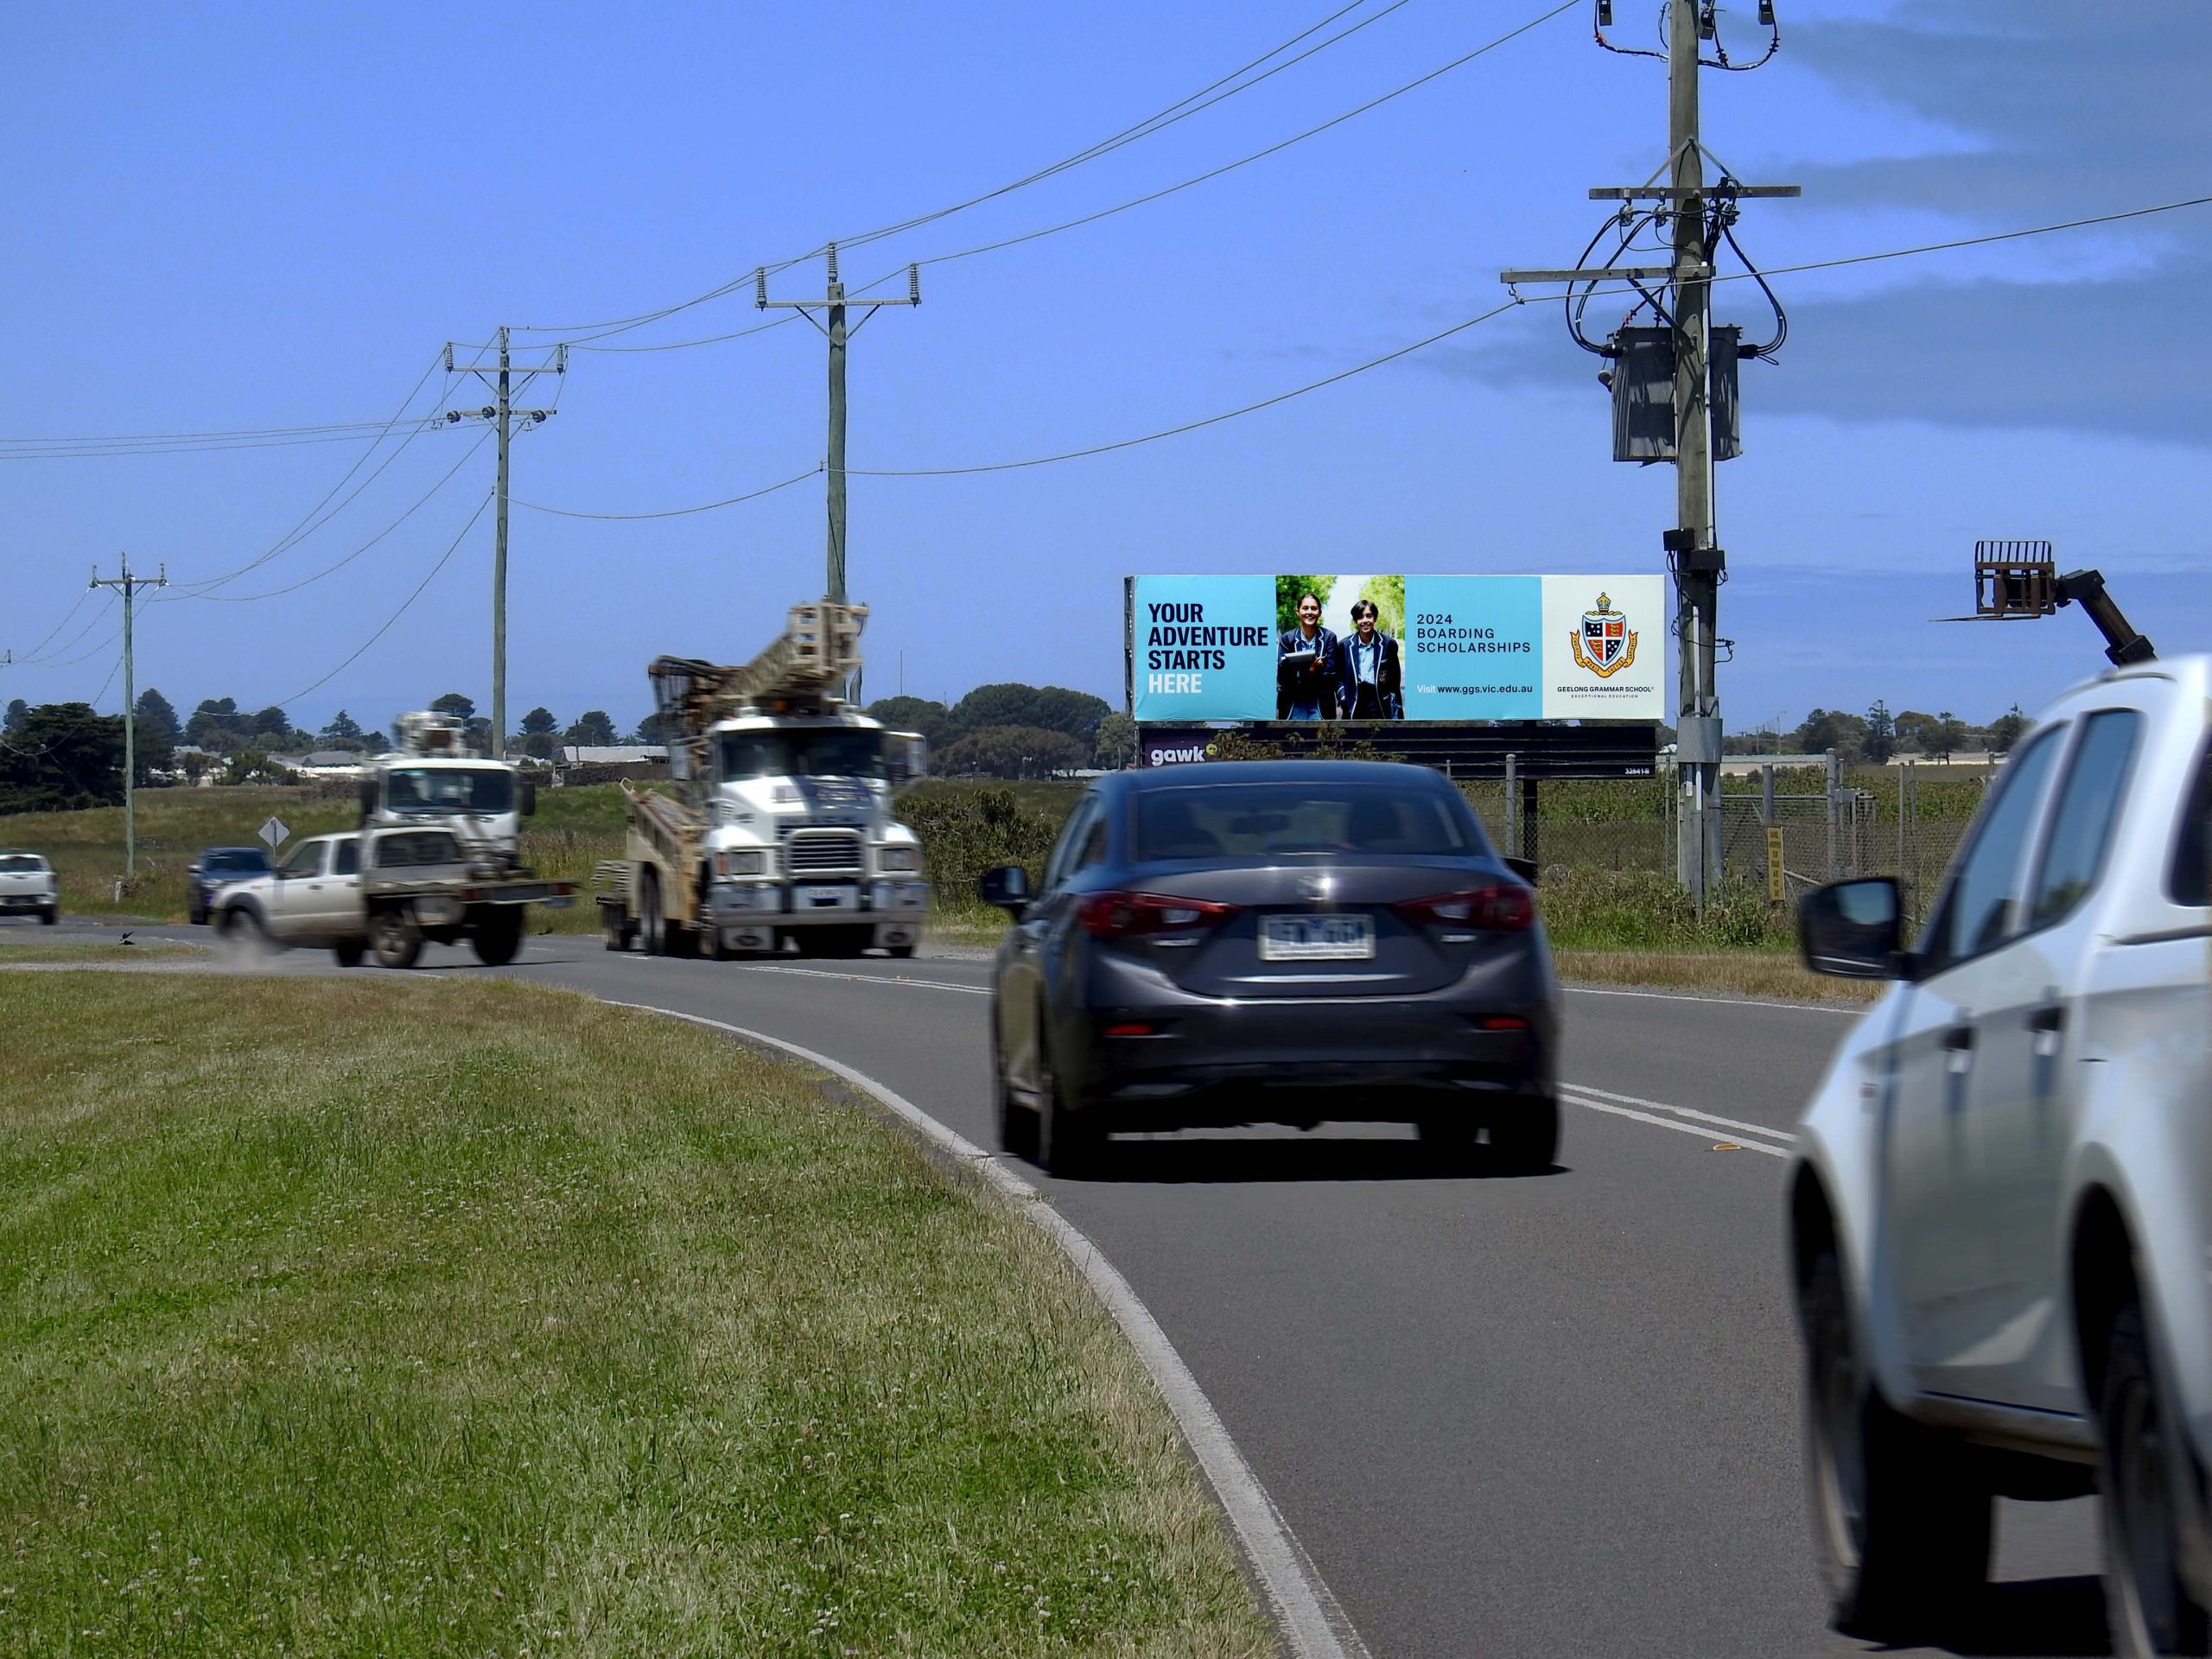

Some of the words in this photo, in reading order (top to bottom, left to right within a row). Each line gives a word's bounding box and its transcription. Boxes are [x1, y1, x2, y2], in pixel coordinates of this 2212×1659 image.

[1147, 603, 1204, 623] YOUR
[1416, 613, 1452, 625] 2024
[1147, 626, 1268, 646] ADVENTURE
[1417, 628, 1494, 639] BOARDING
[1417, 642, 1531, 653] SCHOLARSHIPS
[1147, 650, 1225, 670] STARTS
[1607, 659, 1624, 674] FACTUS
[1148, 673, 1203, 694] HERE
[1416, 684, 1436, 694] Visit
[1437, 685, 1533, 695] www.ggs.vic.edu.au
[1151, 746, 1205, 766] gawk
